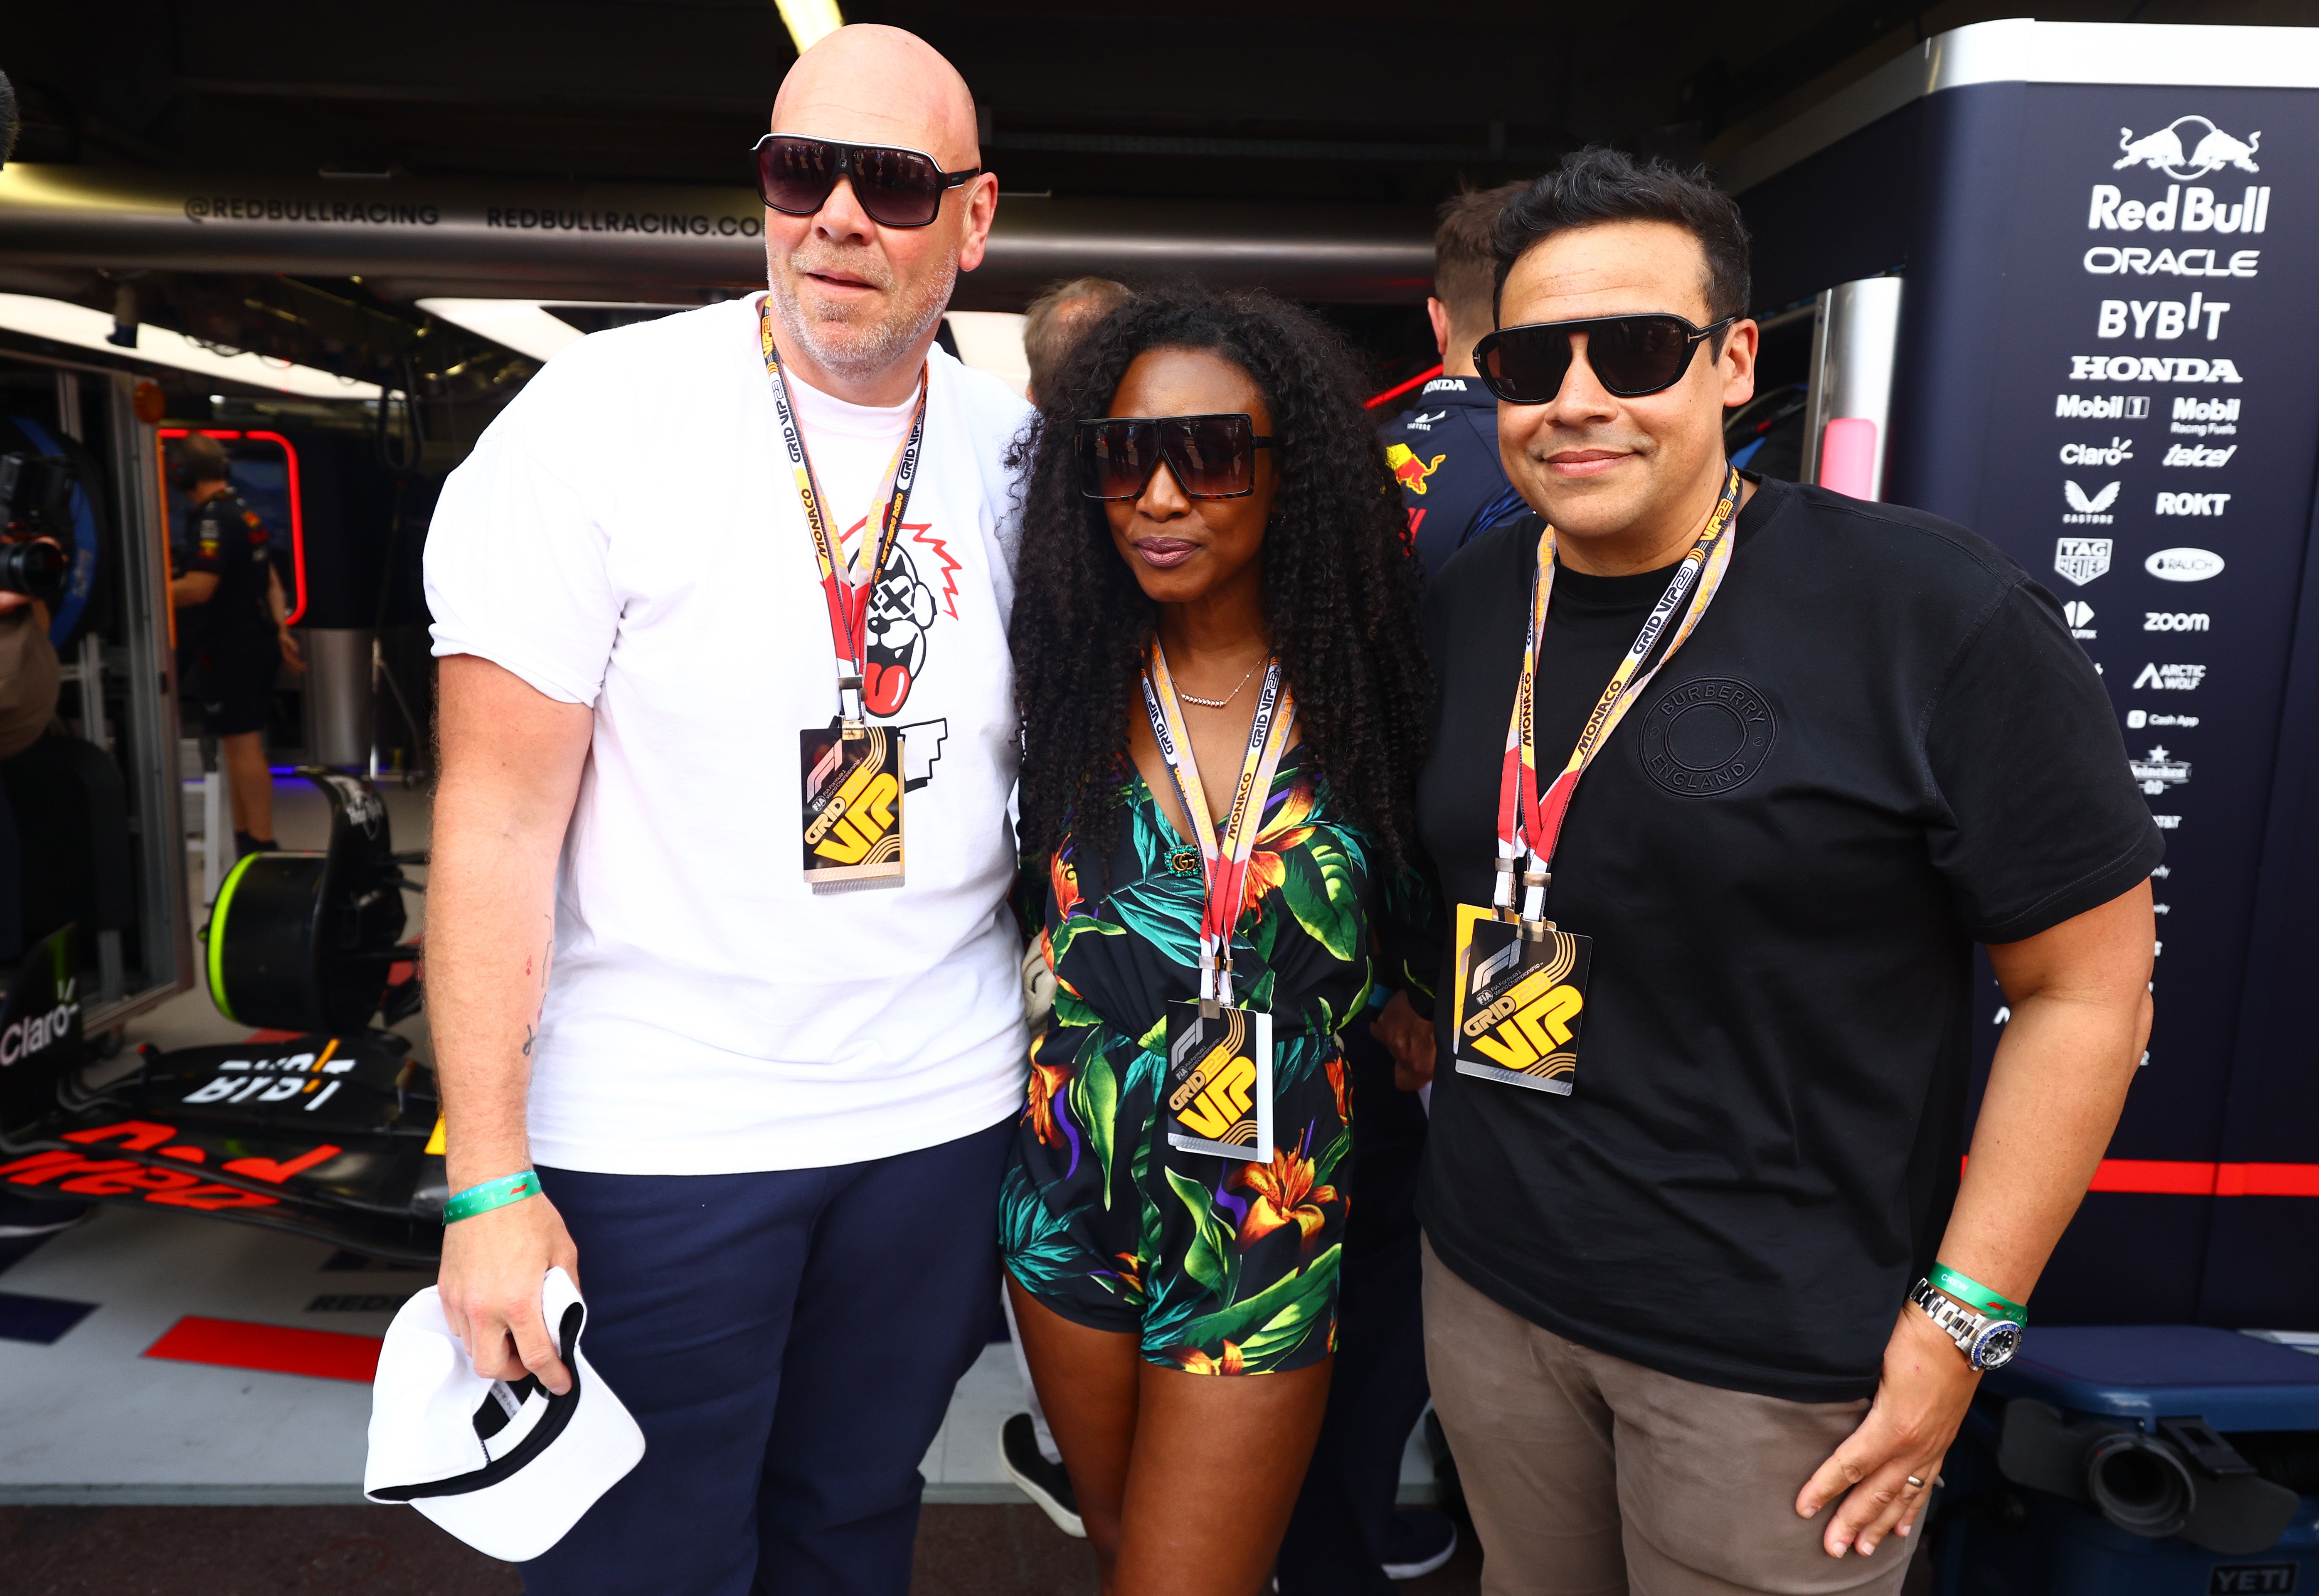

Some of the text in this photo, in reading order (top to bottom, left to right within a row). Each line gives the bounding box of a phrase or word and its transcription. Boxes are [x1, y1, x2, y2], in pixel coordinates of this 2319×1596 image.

[185, 196, 439, 225] @REDBULLRACING
[487, 207, 765, 238] REDBULLRACING.CO
[2088, 185, 2270, 233] Red Bull
[2083, 247, 2260, 277] ORACLE
[2098, 292, 2230, 340] BYBIT
[2069, 356, 2243, 383] HONDA
[1422, 379, 1467, 395] ONDA
[2056, 395, 2124, 418] Mobil
[2172, 397, 2241, 421] Mobil
[783, 427, 801, 463] GRID
[2060, 443, 2122, 466] Claro
[900, 449, 915, 480] GRID
[2063, 514, 2114, 524] CASTORE
[2156, 493, 2231, 516] ROKT
[802, 489, 828, 559] MONACO
[860, 498, 883, 571] MONACO
[2063, 541, 2107, 556] TAG
[2060, 559, 2106, 579] HEUER
[2167, 558, 2214, 571] RAUCH
[1632, 616, 1661, 654] GRID
[2144, 613, 2210, 631] zoom
[2159, 664, 2206, 678] ARCTIC
[2164, 677, 2201, 690] WOLF
[1522, 672, 1532, 747] MONACO
[1578, 680, 1622, 756] MONACO
[1660, 685, 1765, 722] BURBERRY
[1252, 714, 1267, 748] GRID
[2149, 714, 2199, 727] Cash App
[1154, 722, 1173, 755] GRID
[828, 772, 843, 791] Formula
[1651, 754, 1746, 789] ENGLAND
[826, 785, 838, 799] World
[1228, 772, 1252, 840] MONACO
[804, 796, 846, 845] GRID
[813, 773, 898, 864] VIP
[1187, 776, 1215, 845] MONACO
[1238, 776, 1268, 847] MONACO
[1494, 983, 1509, 996] World
[1498, 972, 1518, 987] Formula
[1476, 991, 1493, 1005] FIA
[1464, 995, 1516, 1037] GRID
[1471, 985, 1583, 1069] VIP
[0, 1004, 70, 1067] Claro
[1188, 1059, 1199, 1071] World
[1190, 1048, 1205, 1064] Formula
[1169, 1070, 1206, 1111] GRID
[1176, 1056, 1257, 1138] VIP
[1941, 1273, 1969, 1291] CREW
[2217, 1568, 2289, 1593] YETI
